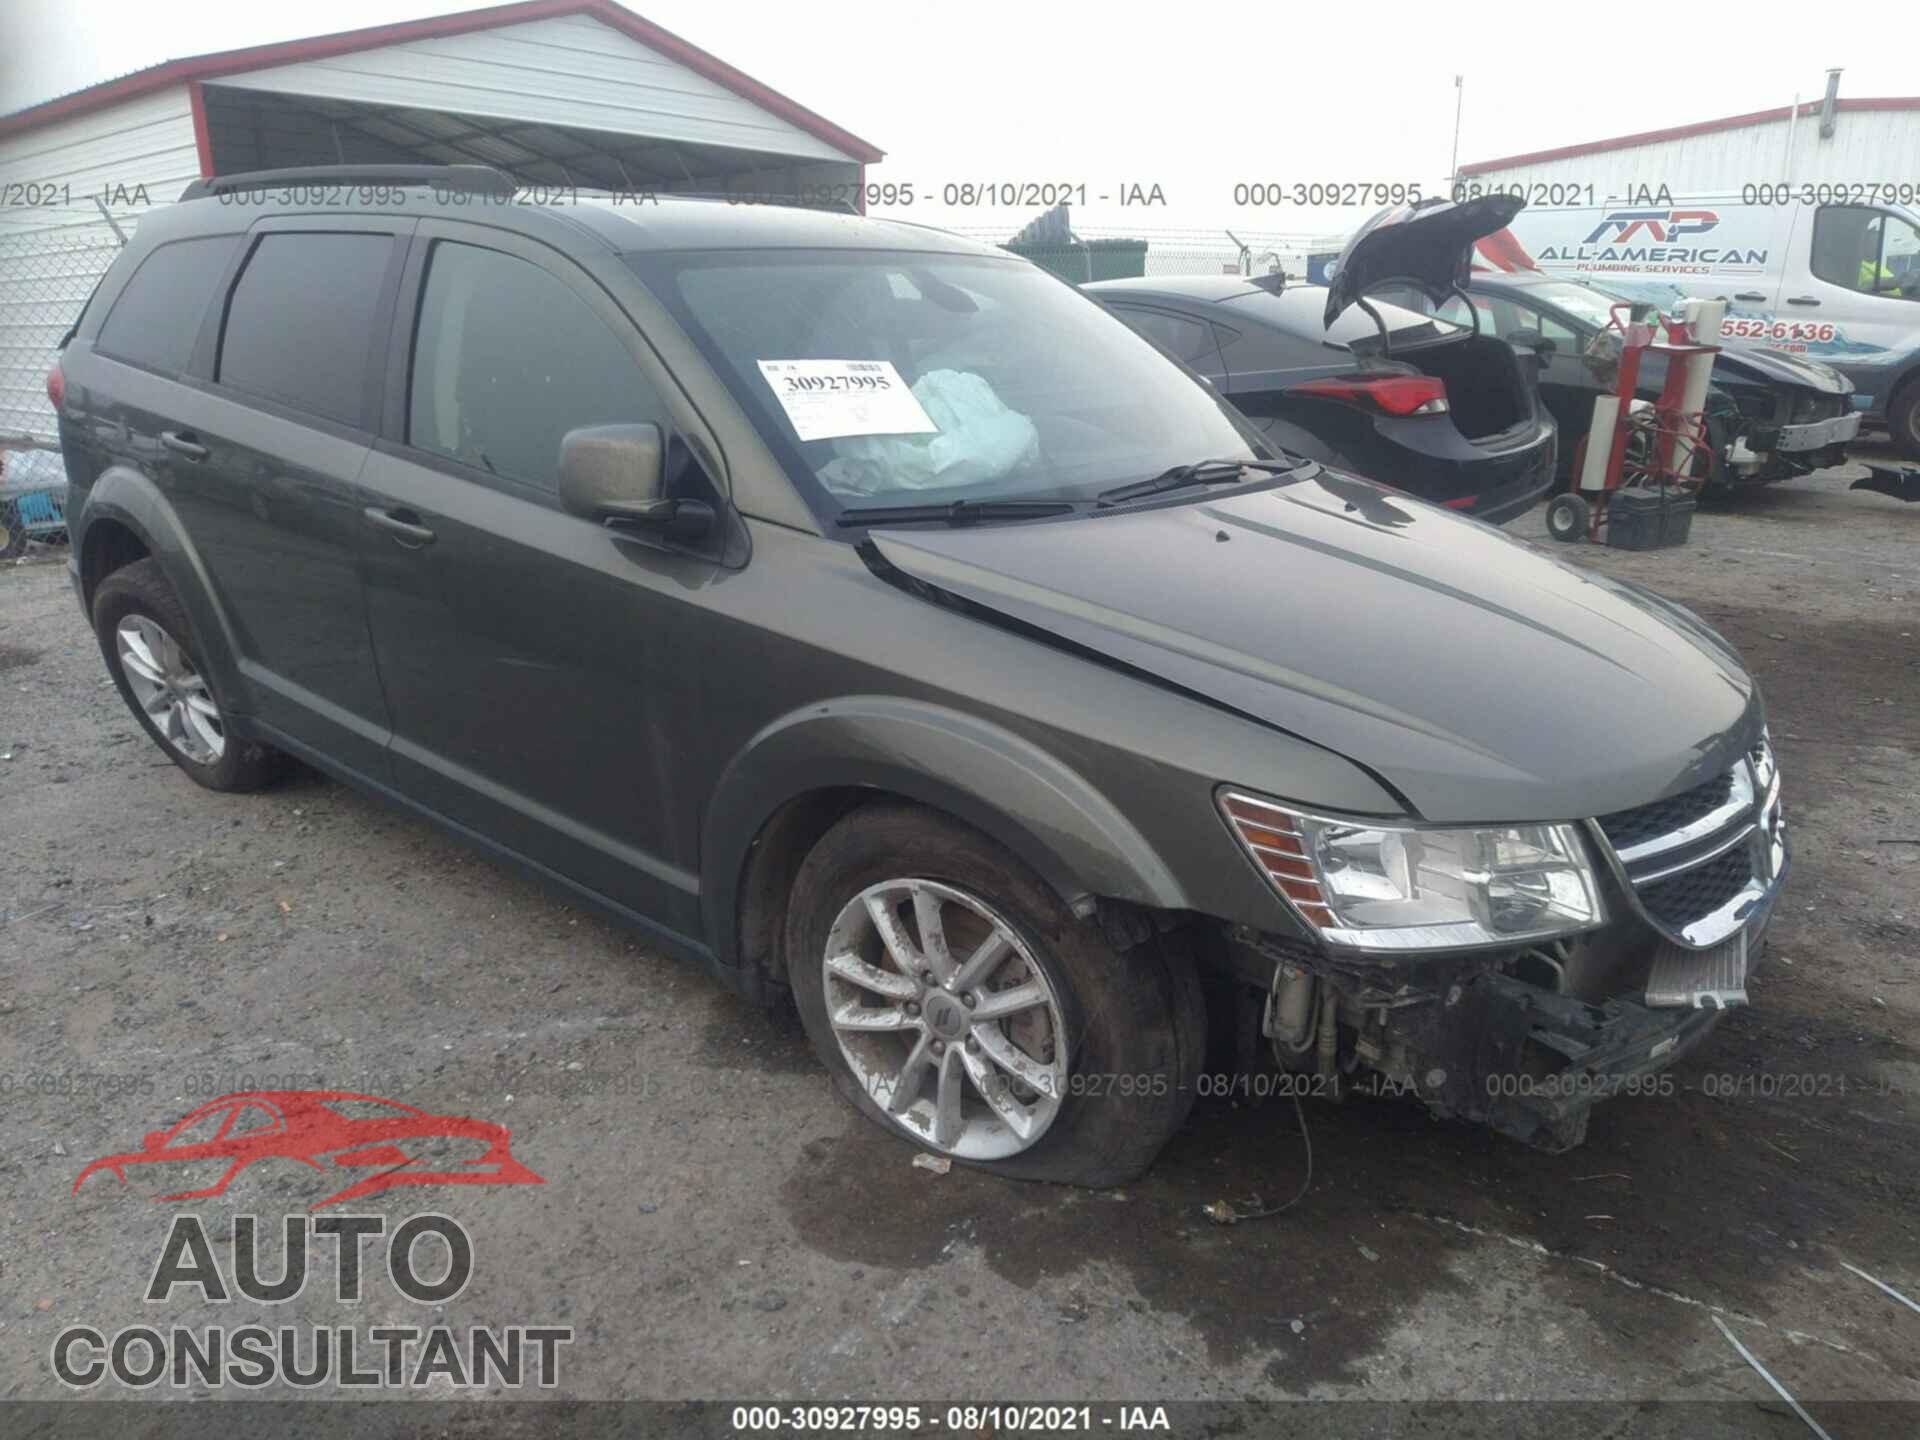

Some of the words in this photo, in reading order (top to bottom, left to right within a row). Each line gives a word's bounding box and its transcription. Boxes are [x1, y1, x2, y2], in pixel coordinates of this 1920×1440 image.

[1538, 246, 1768, 265] ALL-AMERICAN
[1576, 263, 1641, 273] PLUMBING
[1645, 265, 1710, 274] SERVICES
[1720, 320, 1834, 341] 552-6136
[784, 375, 891, 392] 30927995
